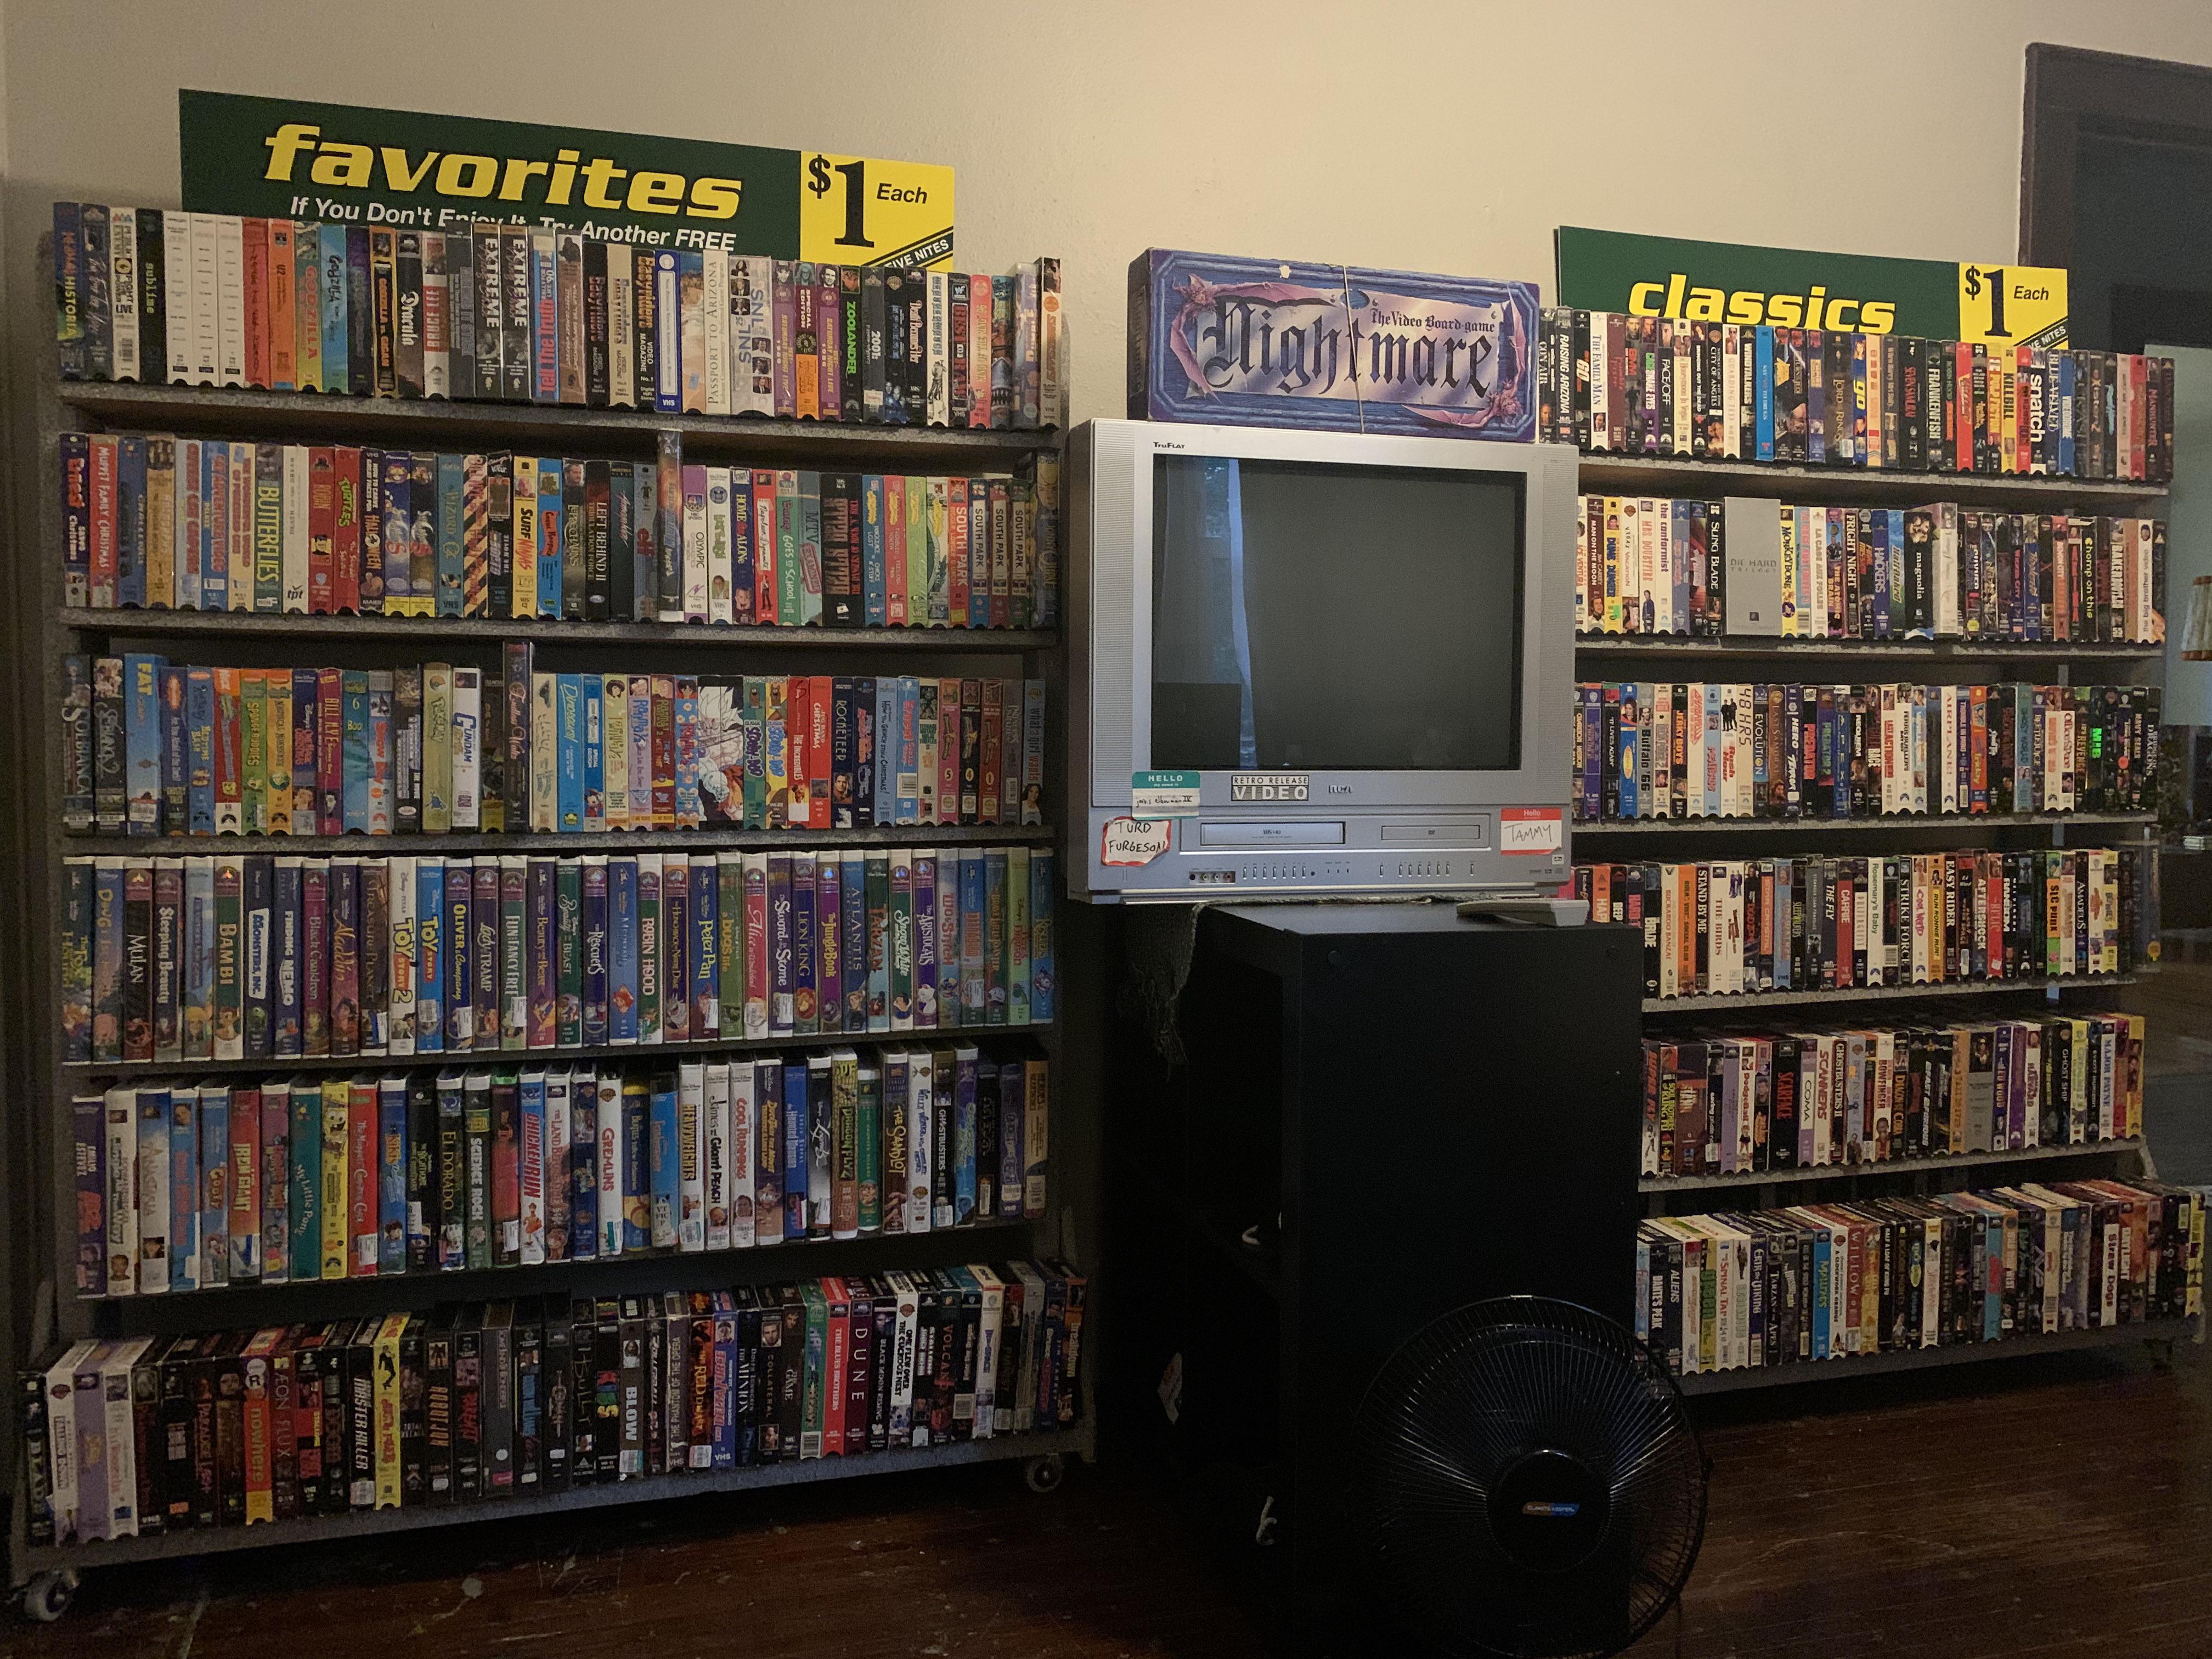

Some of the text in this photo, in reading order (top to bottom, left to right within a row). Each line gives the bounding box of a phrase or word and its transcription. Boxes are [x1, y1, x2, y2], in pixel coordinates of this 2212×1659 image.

[264, 123, 743, 219] favorites
[877, 183, 927, 204] Each
[290, 196, 308, 216] If
[315, 199, 360, 221] You
[366, 203, 432, 226] Don't
[582, 221, 669, 247] Another
[675, 228, 736, 252] FREE
[808, 155, 874, 248] $1
[915, 239, 949, 261] NITES
[64, 276, 78, 337] HISTORIA
[116, 305, 133, 313] LIVE
[145, 263, 158, 314] sublime
[305, 266, 318, 359] GODZILLA
[379, 278, 388, 323] GODZILLA
[486, 238, 499, 327] EXTREME
[636, 256, 654, 328] Easyriders
[752, 289, 764, 328] SNL
[1628, 274, 1895, 334] classics
[1965, 266, 2012, 337] $1
[2013, 286, 2049, 300] Each
[400, 291, 419, 345] Dracula
[427, 290, 439, 346] BRUCE LEE
[538, 300, 555, 391] Tell The Truth
[707, 262, 718, 404] PASSPORT TO ARIZONA
[738, 325, 752, 363] SNL
[847, 301, 857, 374] ZOOLANDER
[871, 331, 881, 359] 2001:
[910, 300, 923, 363] Death Becomes Her
[1371, 308, 1390, 327] The
[1391, 311, 1422, 326] Video
[2041, 326, 2066, 345] NITES
[1203, 298, 1492, 398] Nightmare
[1560, 334, 1570, 413] RAISING ARIZONA
[1711, 364, 1717, 376] OF
[1744, 343, 1752, 404] WINDTALKERS
[1662, 359, 1671, 405] FACE/OFF
[1854, 380, 1866, 410] go
[1929, 369, 1941, 438] FRANKENFISH
[2004, 373, 2014, 419] KILL BILL
[2030, 374, 2045, 442] snatch
[68, 458, 86, 509] Ernest
[98, 447, 111, 567] MUPPET FAMILY CHRISTMAS
[338, 477, 354, 527] TURTLES
[736, 494, 747, 521] HOME
[257, 487, 280, 582] BUTTERFLIES
[516, 507, 535, 571] SURF NINJAS
[596, 502, 607, 527] LEFT
[637, 528, 655, 556] elf
[806, 511, 820, 544] MTV
[1660, 503, 1669, 572] the conformist
[596, 532, 607, 571] BEHIND
[696, 532, 705, 568] OLYMPIC
[956, 506, 967, 587] SOUTH PARK
[1711, 521, 1720, 589] SLING BLADE
[1782, 526, 1793, 589] MONKEYBONE
[1846, 515, 1857, 588] FRIGHT NIGHT
[1874, 548, 1886, 592] HACKERS
[1914, 552, 1923, 599] magnolia
[138, 663, 152, 695] FAT
[1740, 687, 1752, 709] 48
[62, 708, 92, 793] SOLBIANCA
[452, 713, 476, 762] GUNDAM
[794, 735, 804, 780] THE INCREDIBLES
[836, 701, 847, 761] ROCKETEER
[1641, 729, 1651, 791] Buffalo '66
[1804, 724, 1815, 778] PREDATOR
[1234, 786, 1308, 800] VIDEO
[1115, 822, 1152, 834] TURD
[1504, 823, 1552, 842] TAMMY
[1698, 870, 1708, 934] STAND BY ME
[1826, 885, 1835, 919] THE FLY
[1842, 889, 1850, 923] CARRIE
[1901, 879, 1910, 965] STRIKE FORCE
[1946, 861, 1955, 926] EASY RIDER
[128, 935, 147, 983] MULAN
[157, 907, 174, 1003] Sleeping Beauty
[219, 924, 237, 984] BAMBI
[284, 911, 295, 1005] FINDING NEMO
[334, 909, 356, 981] Aladdin
[698, 920, 716, 979] Peter Pan
[798, 911, 810, 976] LION KING
[851, 888, 862, 970] ATLANTIS
[870, 904, 887, 972] TARZAN
[393, 918, 414, 1003] TOY STORY 2
[1777, 1071, 1794, 1119] SCARFACE
[1804, 1080, 1812, 1121] COMA
[1818, 1050, 1829, 1120] SCANNERS
[1877, 1060, 1887, 1109] BOWFINGER
[524, 1113, 541, 1198] CHICKEN RUN
[602, 1127, 615, 1191] GREMLINS
[682, 1104, 697, 1180] HEAVYWEIGHTS
[1671, 1269, 1679, 1302] ALIENS
[1850, 1232, 1860, 1294] WILLOW
[2106, 1234, 2117, 1307] Straw Dogs
[851, 1328, 868, 1401] DUNE
[354, 1378, 368, 1469] MASTER KILLER
[625, 1387, 637, 1441] BLOW
